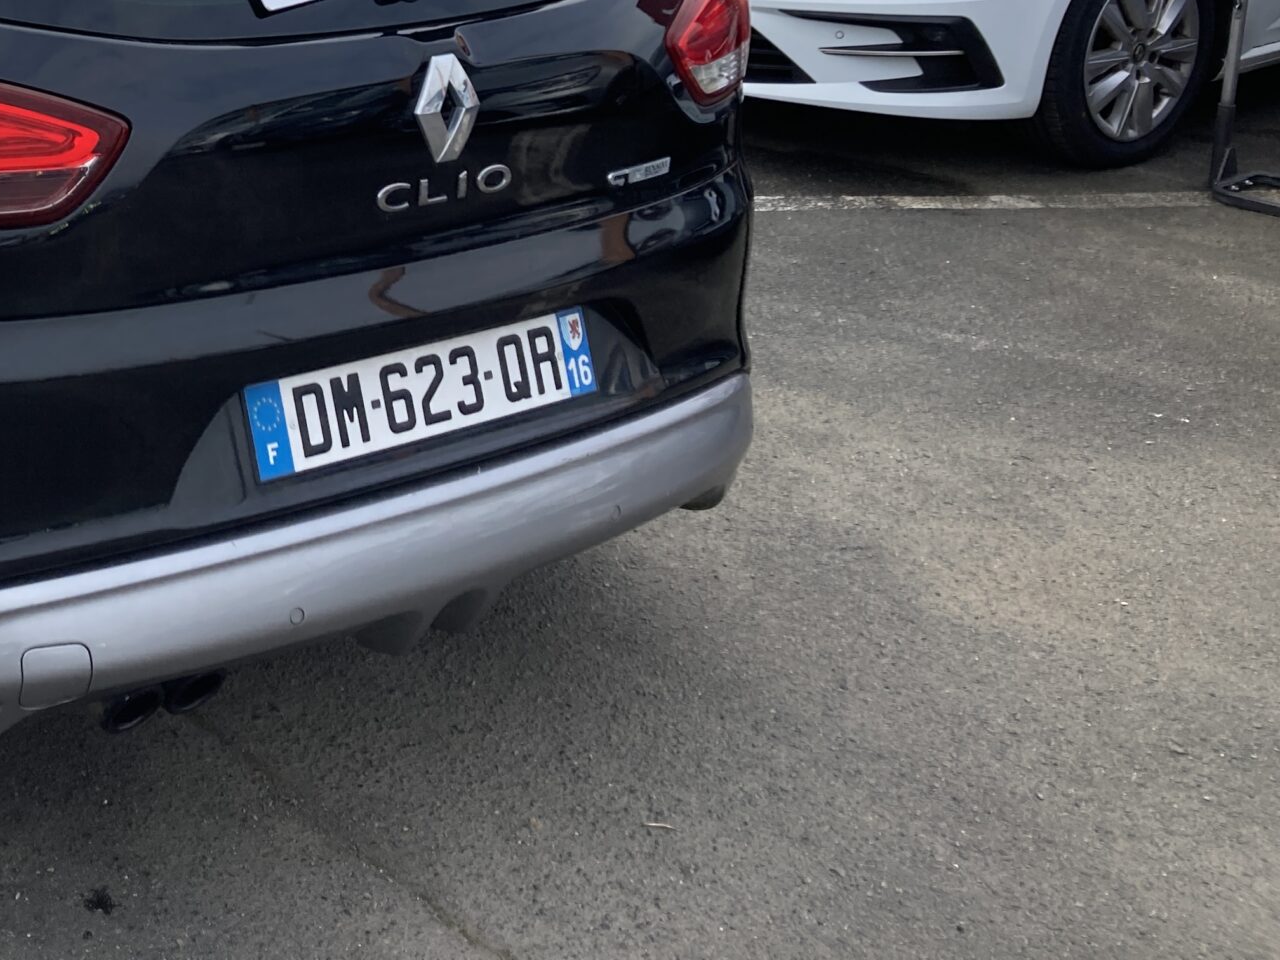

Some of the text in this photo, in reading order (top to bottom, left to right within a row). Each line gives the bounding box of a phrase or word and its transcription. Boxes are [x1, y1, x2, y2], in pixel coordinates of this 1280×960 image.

[377, 164, 512, 212] CLIO
[267, 326, 593, 465] F DM-623-QR 16
